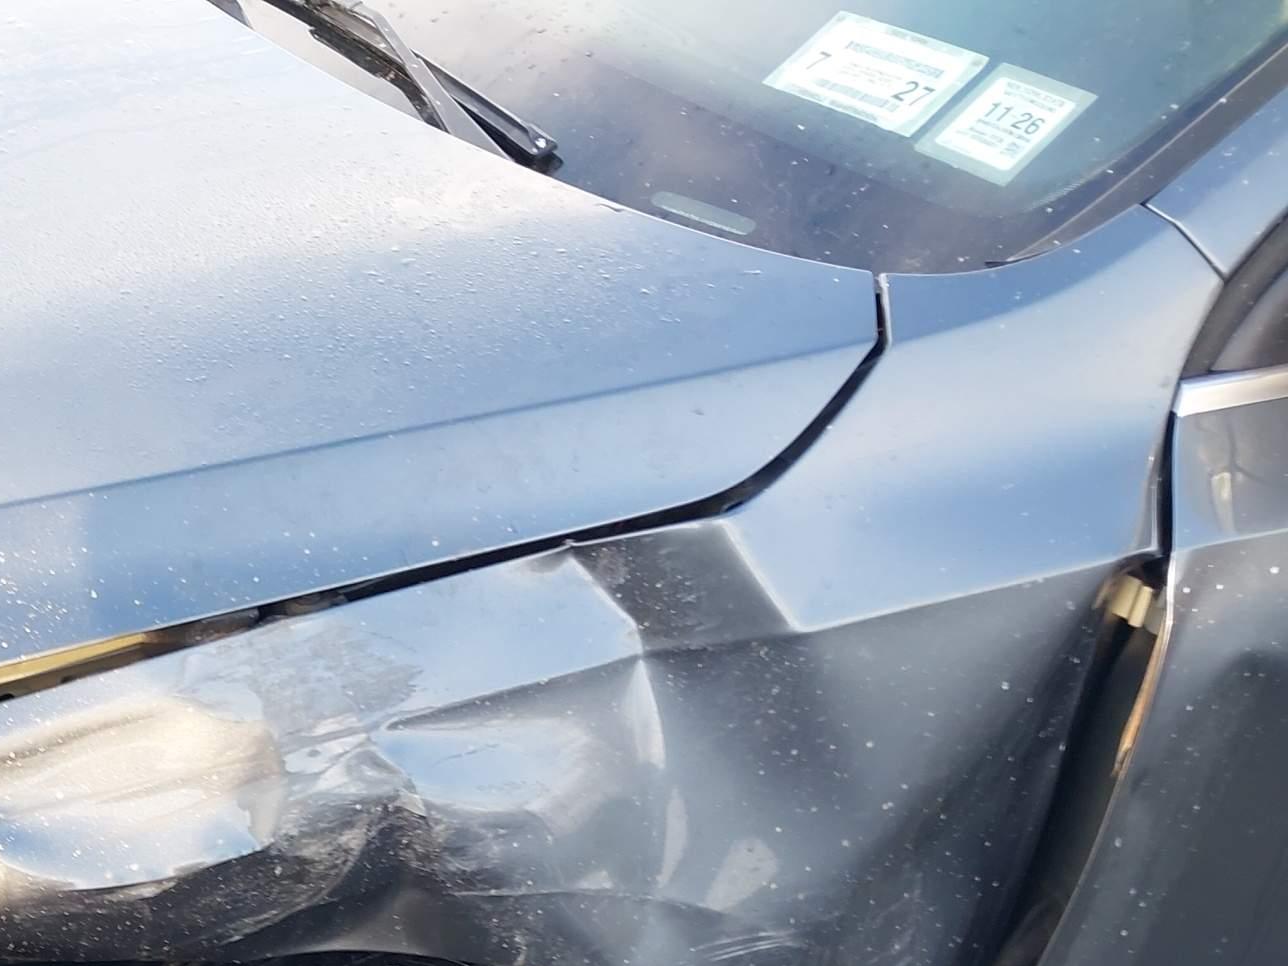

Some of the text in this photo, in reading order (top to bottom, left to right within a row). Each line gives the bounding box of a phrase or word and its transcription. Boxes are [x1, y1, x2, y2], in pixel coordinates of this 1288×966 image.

[805, 50, 833, 71] 7
[890, 80, 936, 107] 27
[1010, 112, 1046, 135] 26
